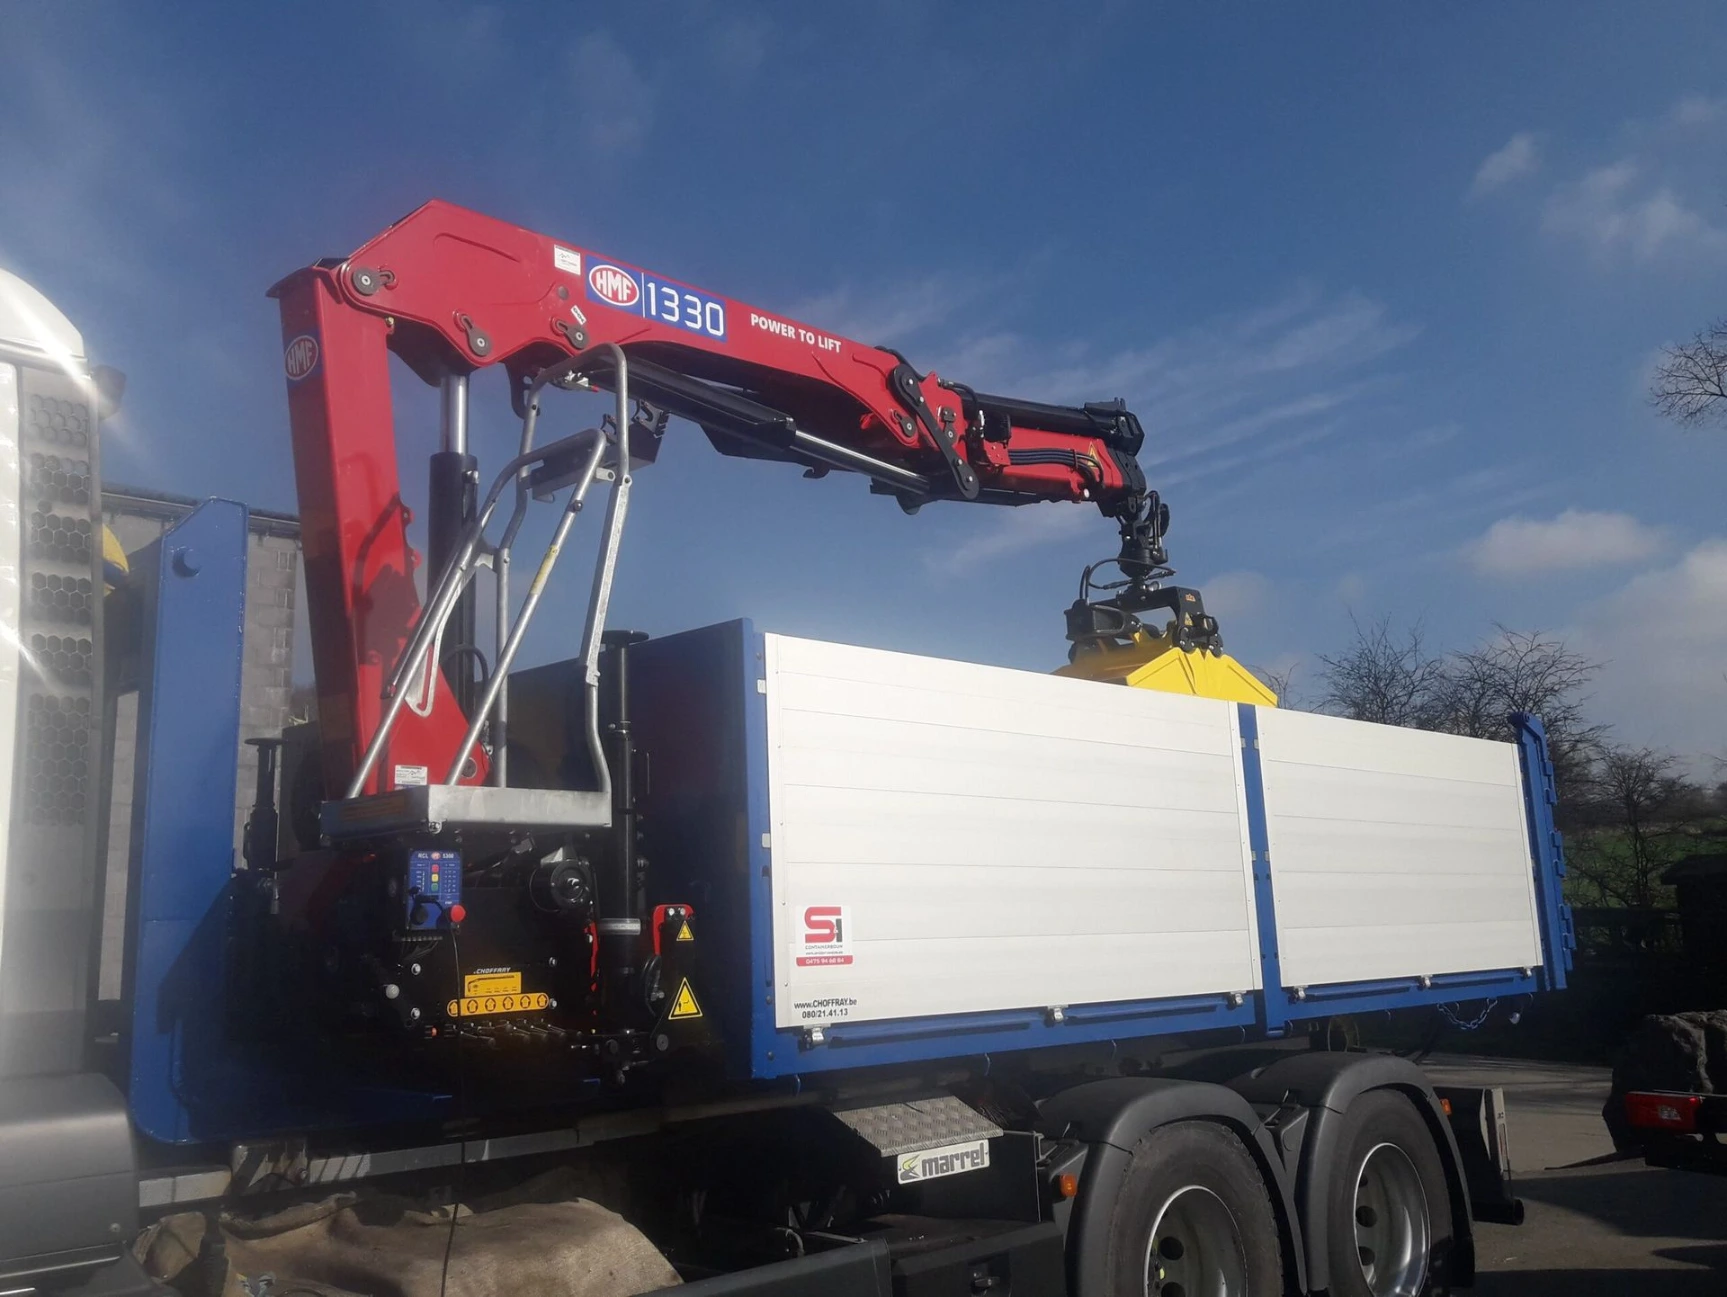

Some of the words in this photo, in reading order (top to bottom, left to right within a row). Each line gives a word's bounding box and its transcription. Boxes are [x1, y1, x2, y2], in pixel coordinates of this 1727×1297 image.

[595, 270, 632, 301] HMF
[647, 282, 724, 336] 1330
[750, 313, 796, 339] POWER
[798, 328, 815, 345] TO
[818, 335, 842, 353] LIFT
[287, 340, 313, 375] HMF
[794, 998, 857, 1009] www.CHOFFRAY.be
[802, 1008, 848, 1019] 080/21.41.13
[922, 1142, 984, 1177] marrel
